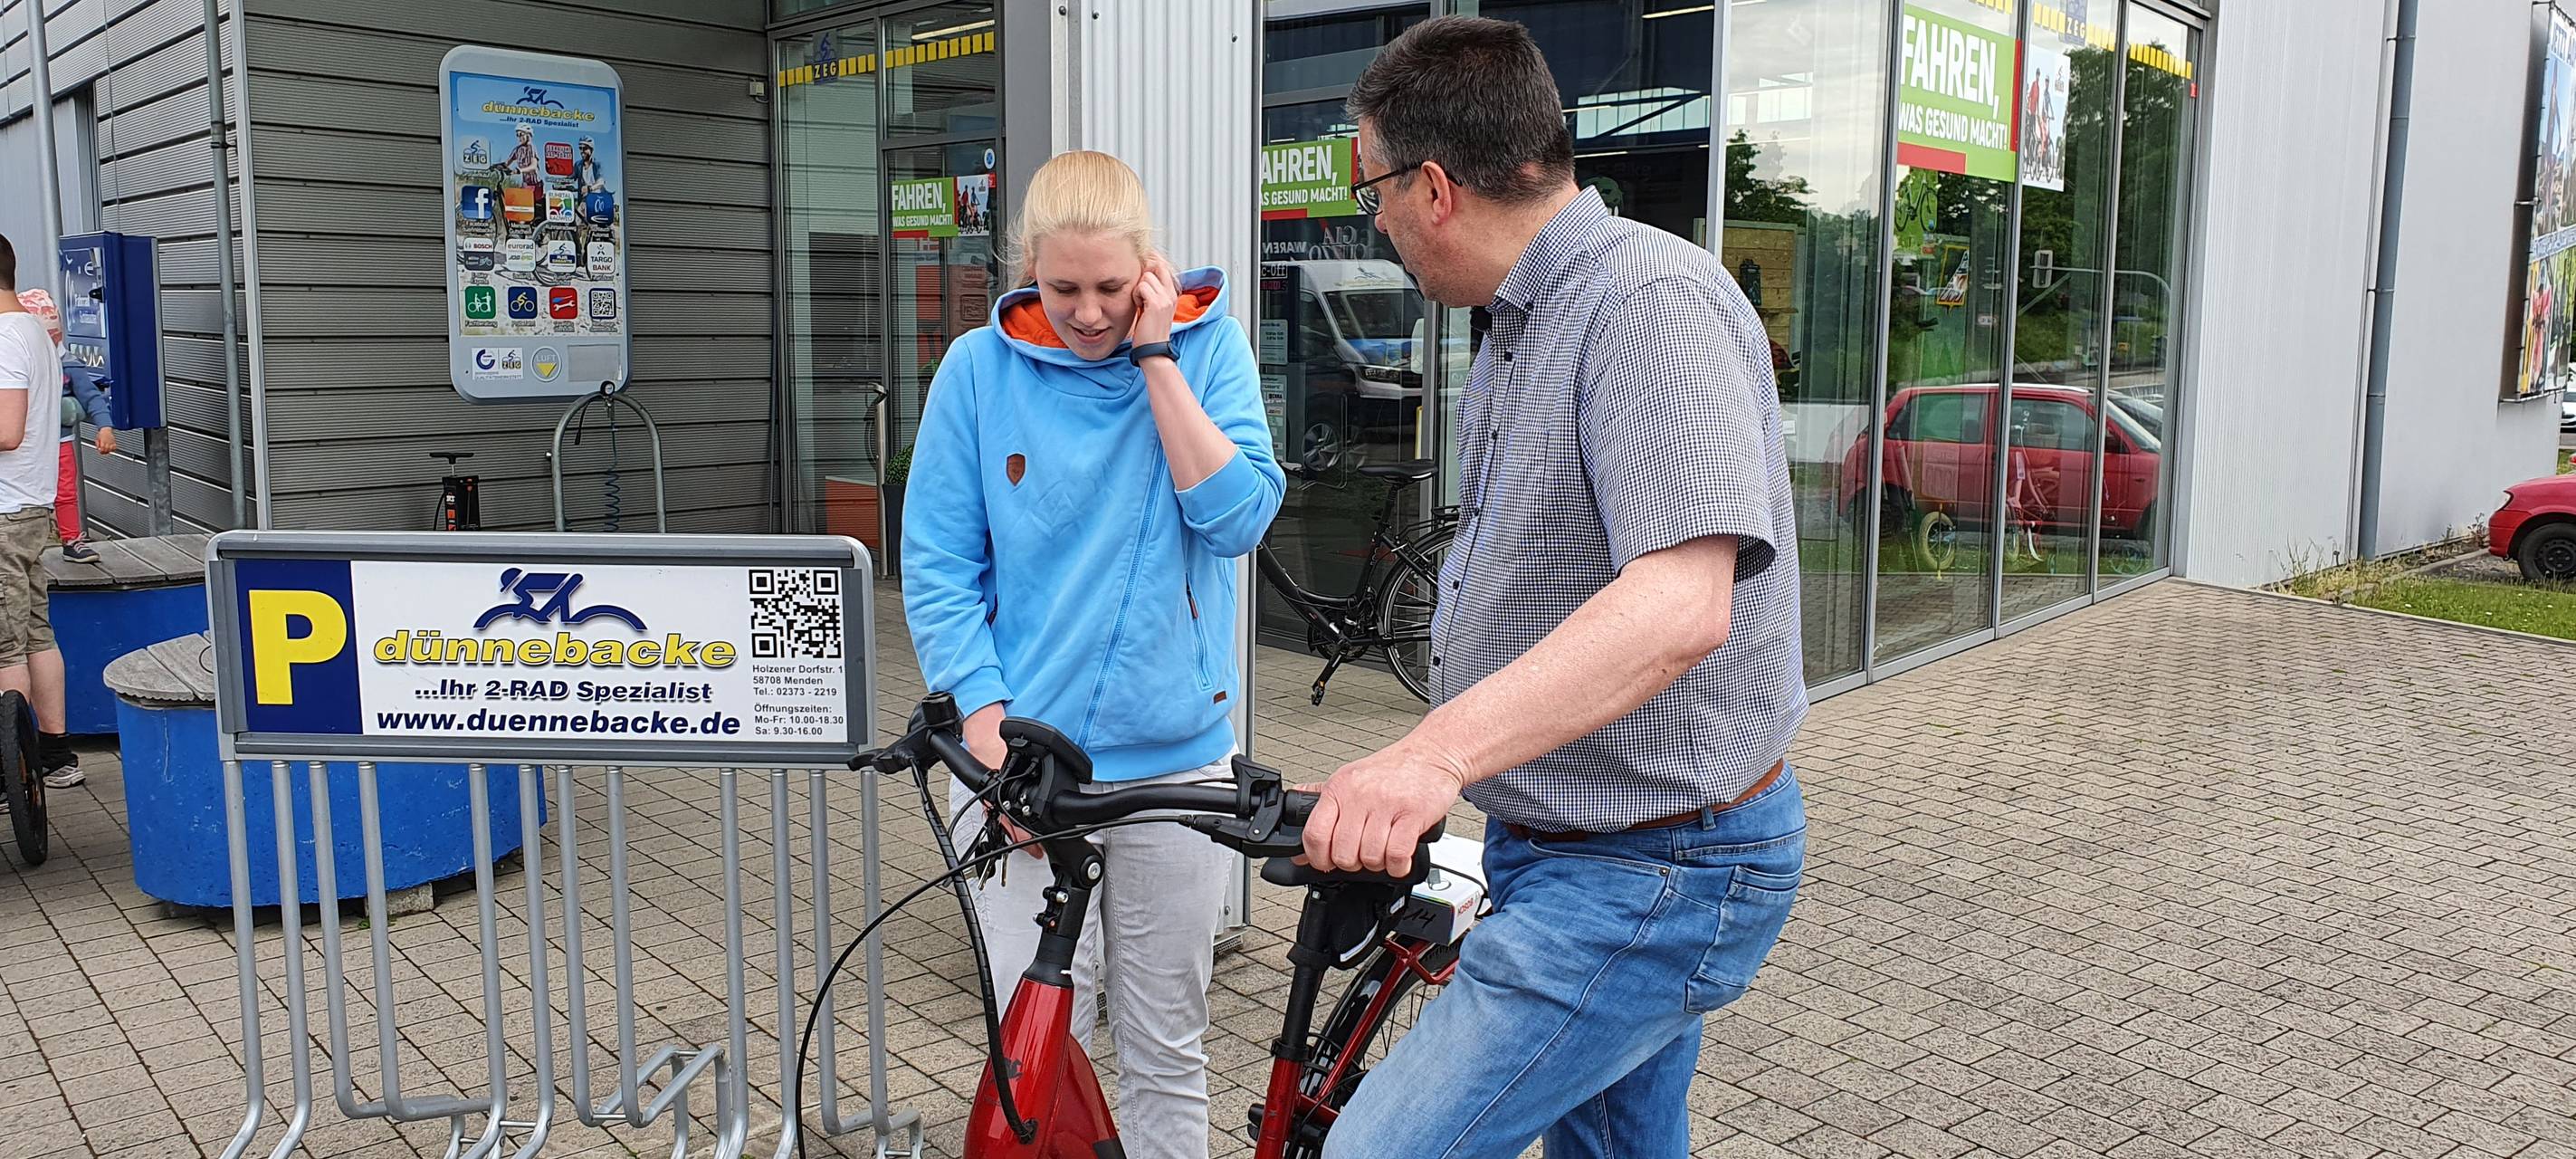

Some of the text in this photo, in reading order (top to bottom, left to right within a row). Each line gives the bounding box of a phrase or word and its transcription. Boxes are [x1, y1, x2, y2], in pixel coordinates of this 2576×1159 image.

[2066, 16, 2085, 39] ZEG
[815, 62, 837, 79] ZEG
[1901, 14, 1999, 120] FAHREN,
[482, 101, 595, 121] dünnebacke
[544, 120, 579, 128] Spezialist
[1898, 102, 2008, 151] WAS GESUND MACHT!
[463, 154, 487, 163] ZEG
[1261, 145, 1337, 186] AHREN,
[892, 182, 946, 214] FAHREN,
[1261, 186, 1348, 206] AS GESUND MACHT!
[892, 214, 953, 226] WAS GESUND MACHT!
[1261, 263, 1285, 276] c-Off
[249, 590, 347, 704] P
[373, 629, 738, 667] dünnebacke
[752, 665, 843, 674] Holzener Dorfstr. 1
[753, 675, 823, 685] 58708 Menden
[415, 679, 711, 703] ...Ihr 2-RAD Spezialist
[753, 687, 773, 695] Tel.:
[777, 688, 805, 696] 02373
[814, 688, 837, 696] 2219
[754, 703, 832, 714] Öffnungszeiten:
[377, 708, 740, 735] www.duennebacke.de
[754, 715, 844, 724] Mo-Fr: 10.00-18.30
[755, 726, 823, 735] Sa: 9.30-16.00
